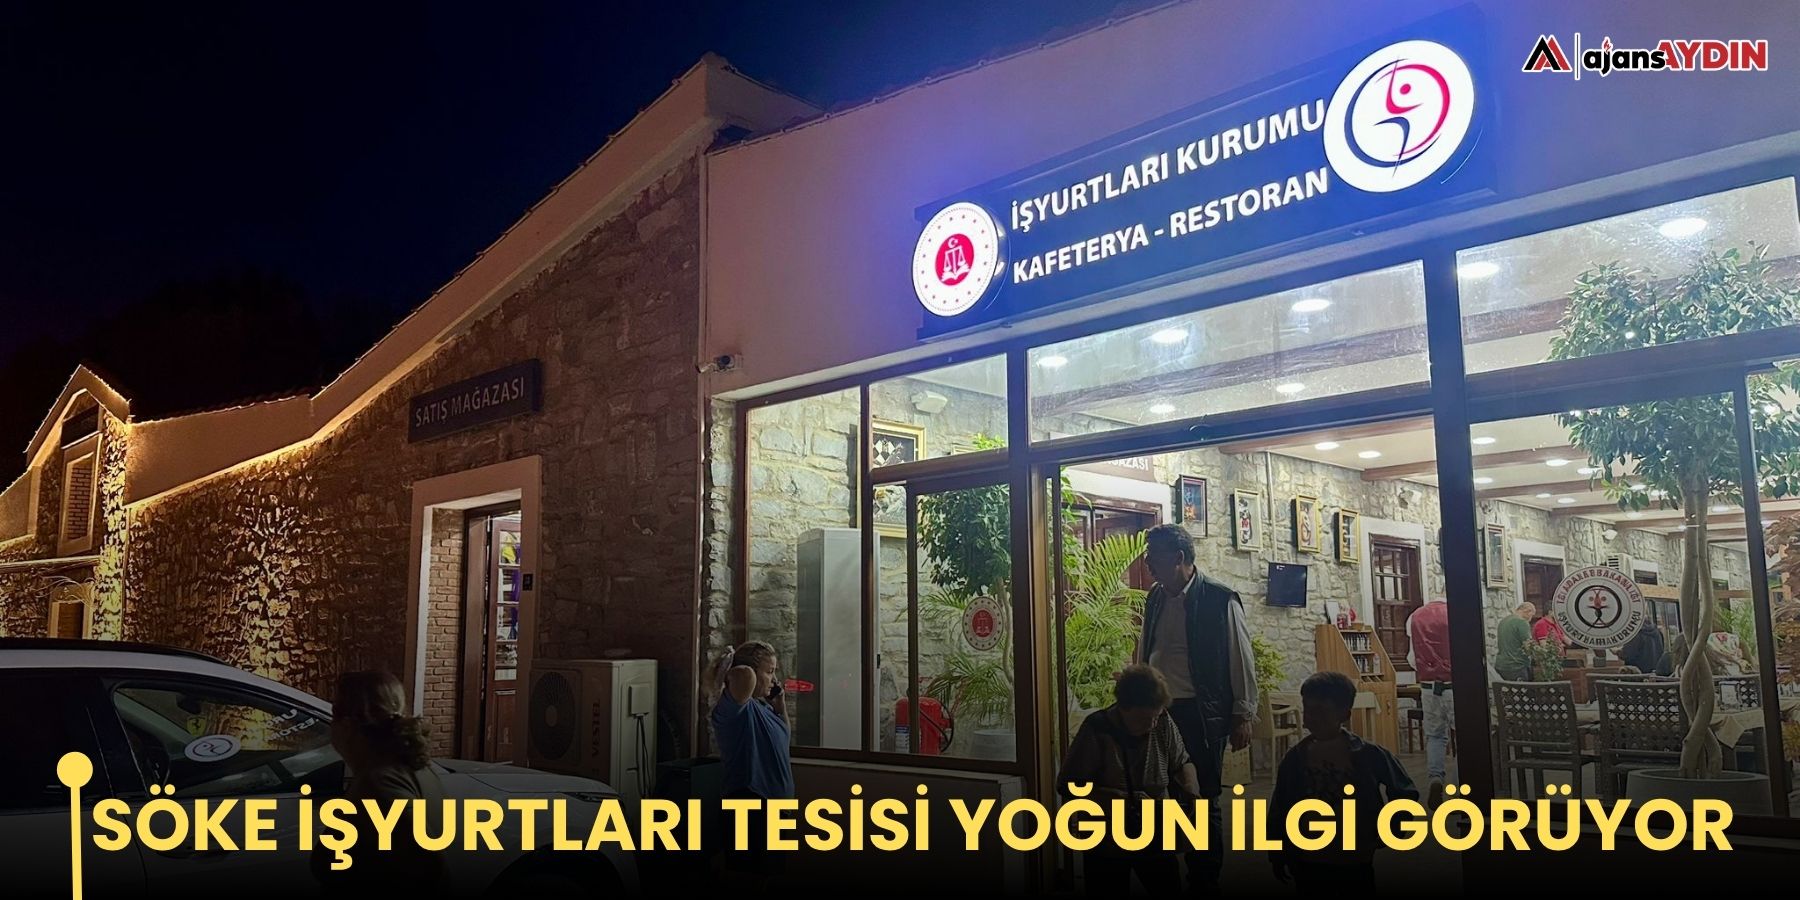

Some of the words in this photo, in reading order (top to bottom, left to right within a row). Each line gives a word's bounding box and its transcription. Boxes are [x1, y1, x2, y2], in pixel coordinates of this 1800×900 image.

[1011, 153, 1169, 233] İŞYURTLARI
[1175, 99, 1325, 175] KURUMU
[1012, 226, 1149, 284] KAFETERYA
[1169, 167, 1329, 238] RESTORAN
[414, 399, 449, 428] SATIŞ
[451, 376, 525, 416] MAĞAZASI
